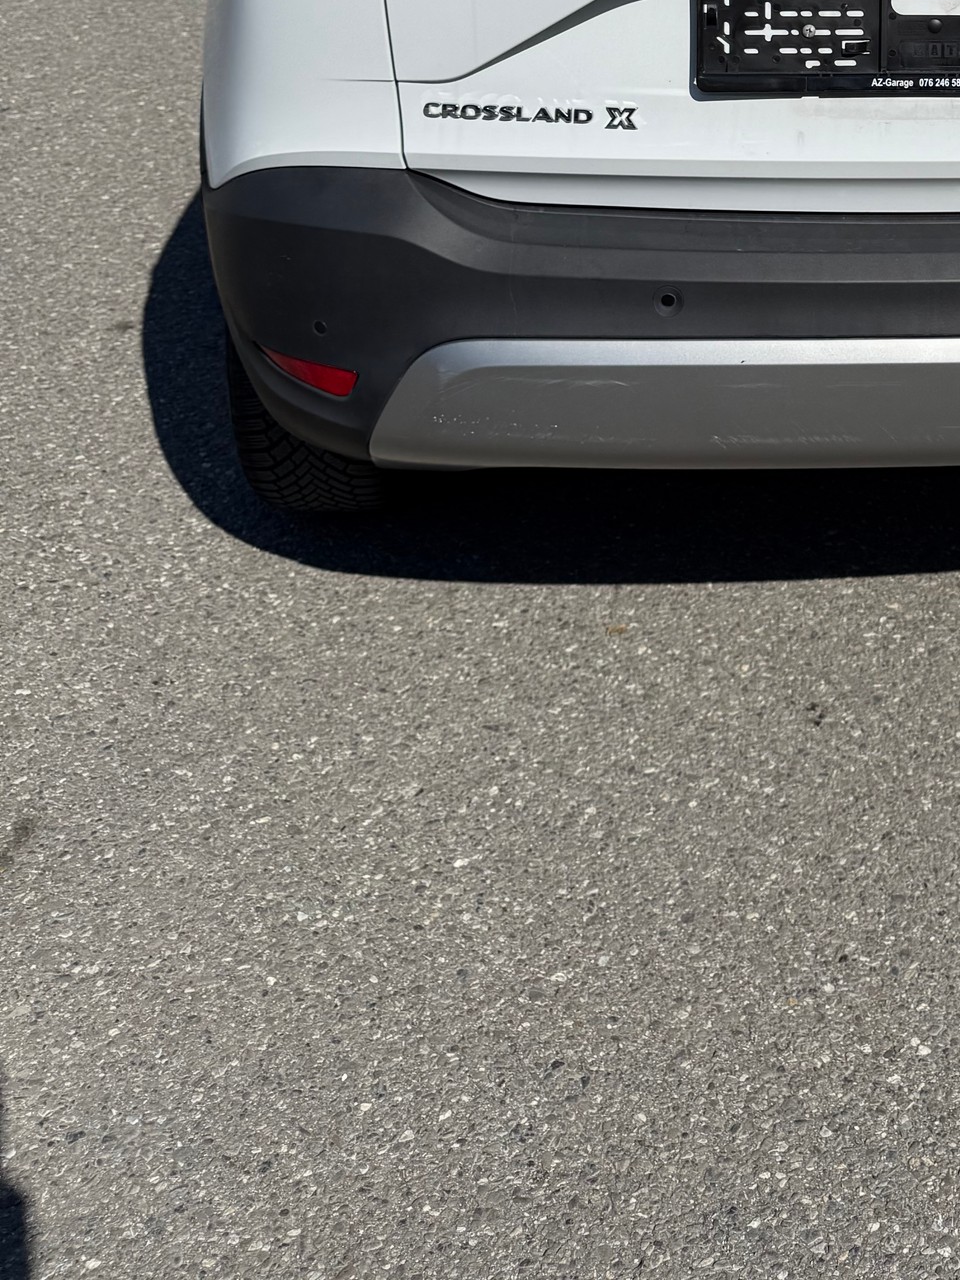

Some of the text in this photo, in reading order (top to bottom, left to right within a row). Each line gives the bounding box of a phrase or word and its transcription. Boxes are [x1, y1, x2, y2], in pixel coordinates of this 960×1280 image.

[871, 78, 914, 89] AZ-Garage
[919, 78, 933, 87] 076
[935, 78, 950, 87] 246
[951, 78, 960, 87] 58
[422, 102, 639, 130] CROSSLAND X
